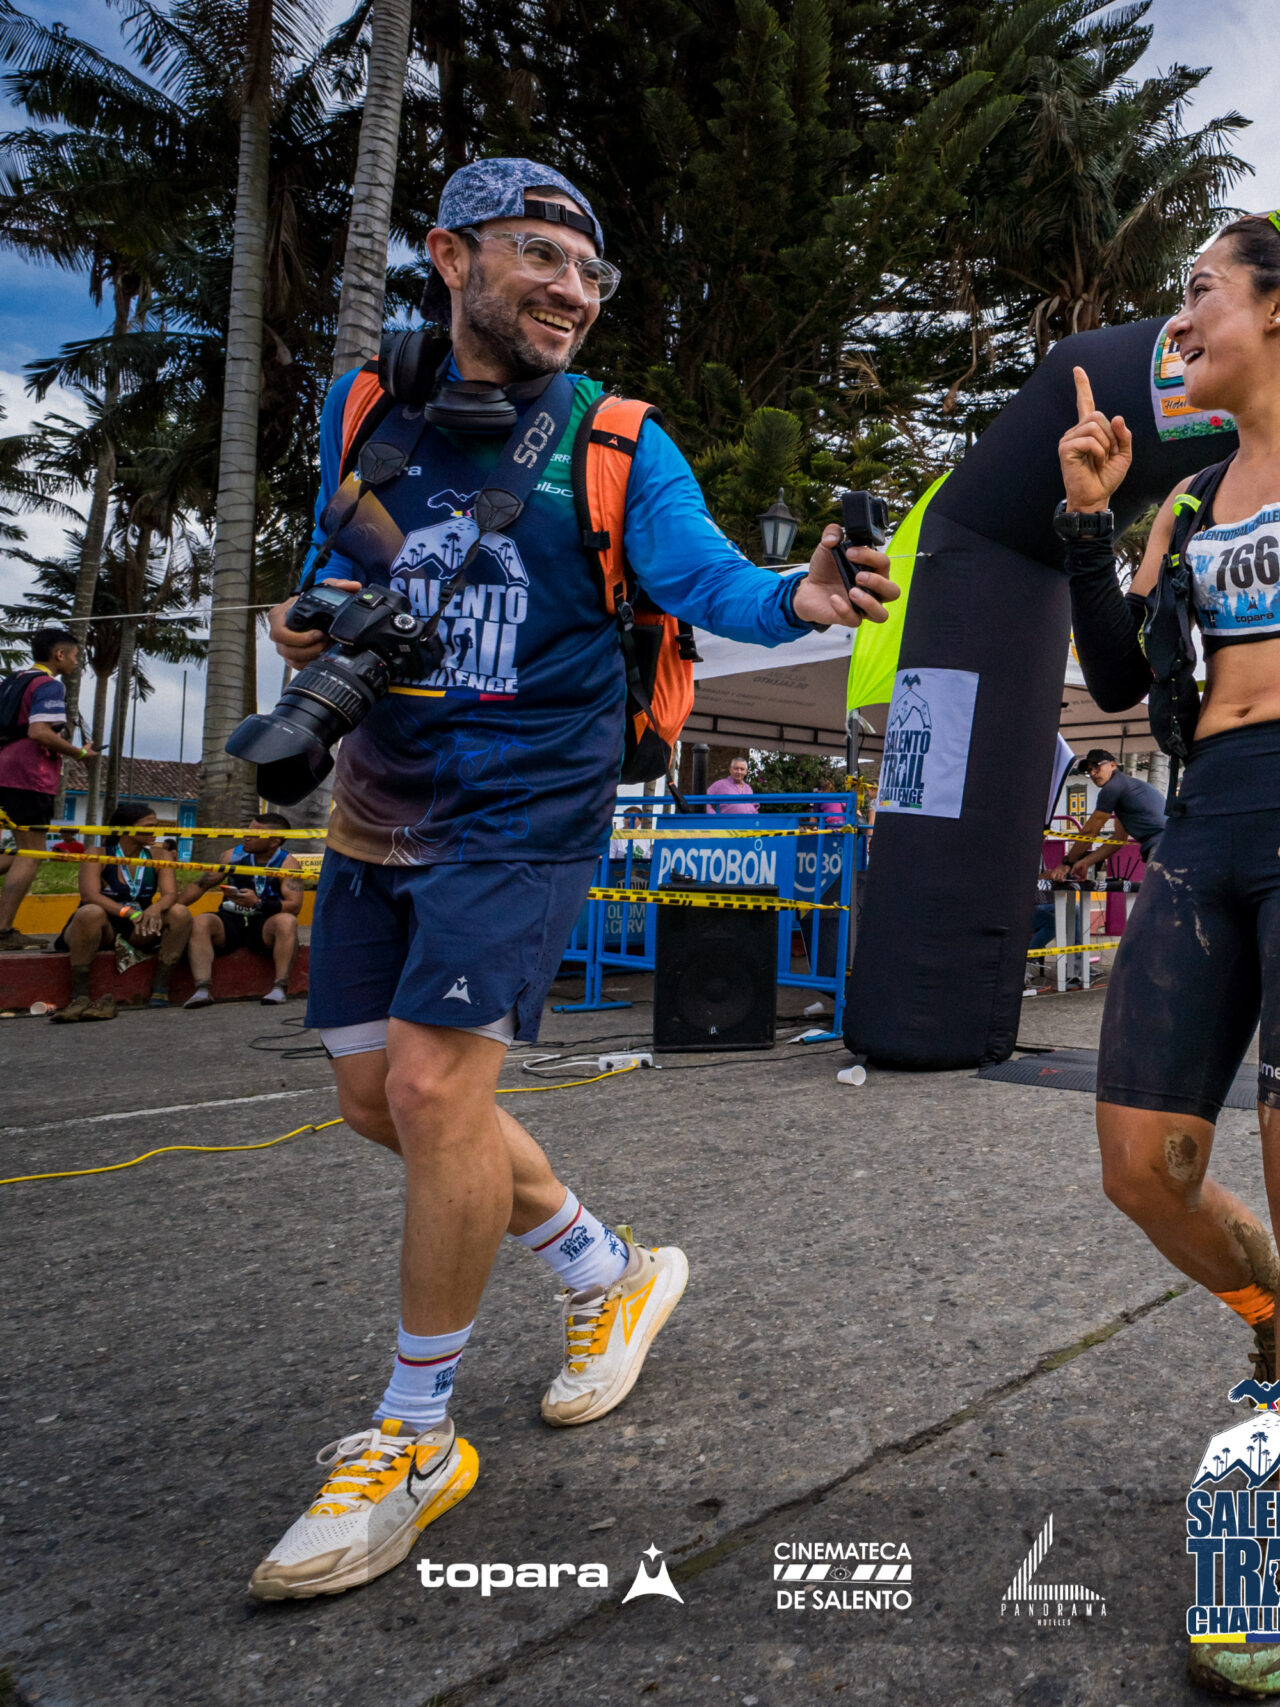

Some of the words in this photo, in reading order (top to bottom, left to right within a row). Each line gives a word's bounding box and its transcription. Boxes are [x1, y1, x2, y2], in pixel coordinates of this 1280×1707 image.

[513, 411, 555, 469] EOS
[1235, 612, 1274, 624] topara
[885, 730, 931, 754] SALENTO
[882, 754, 925, 789] TRAIL
